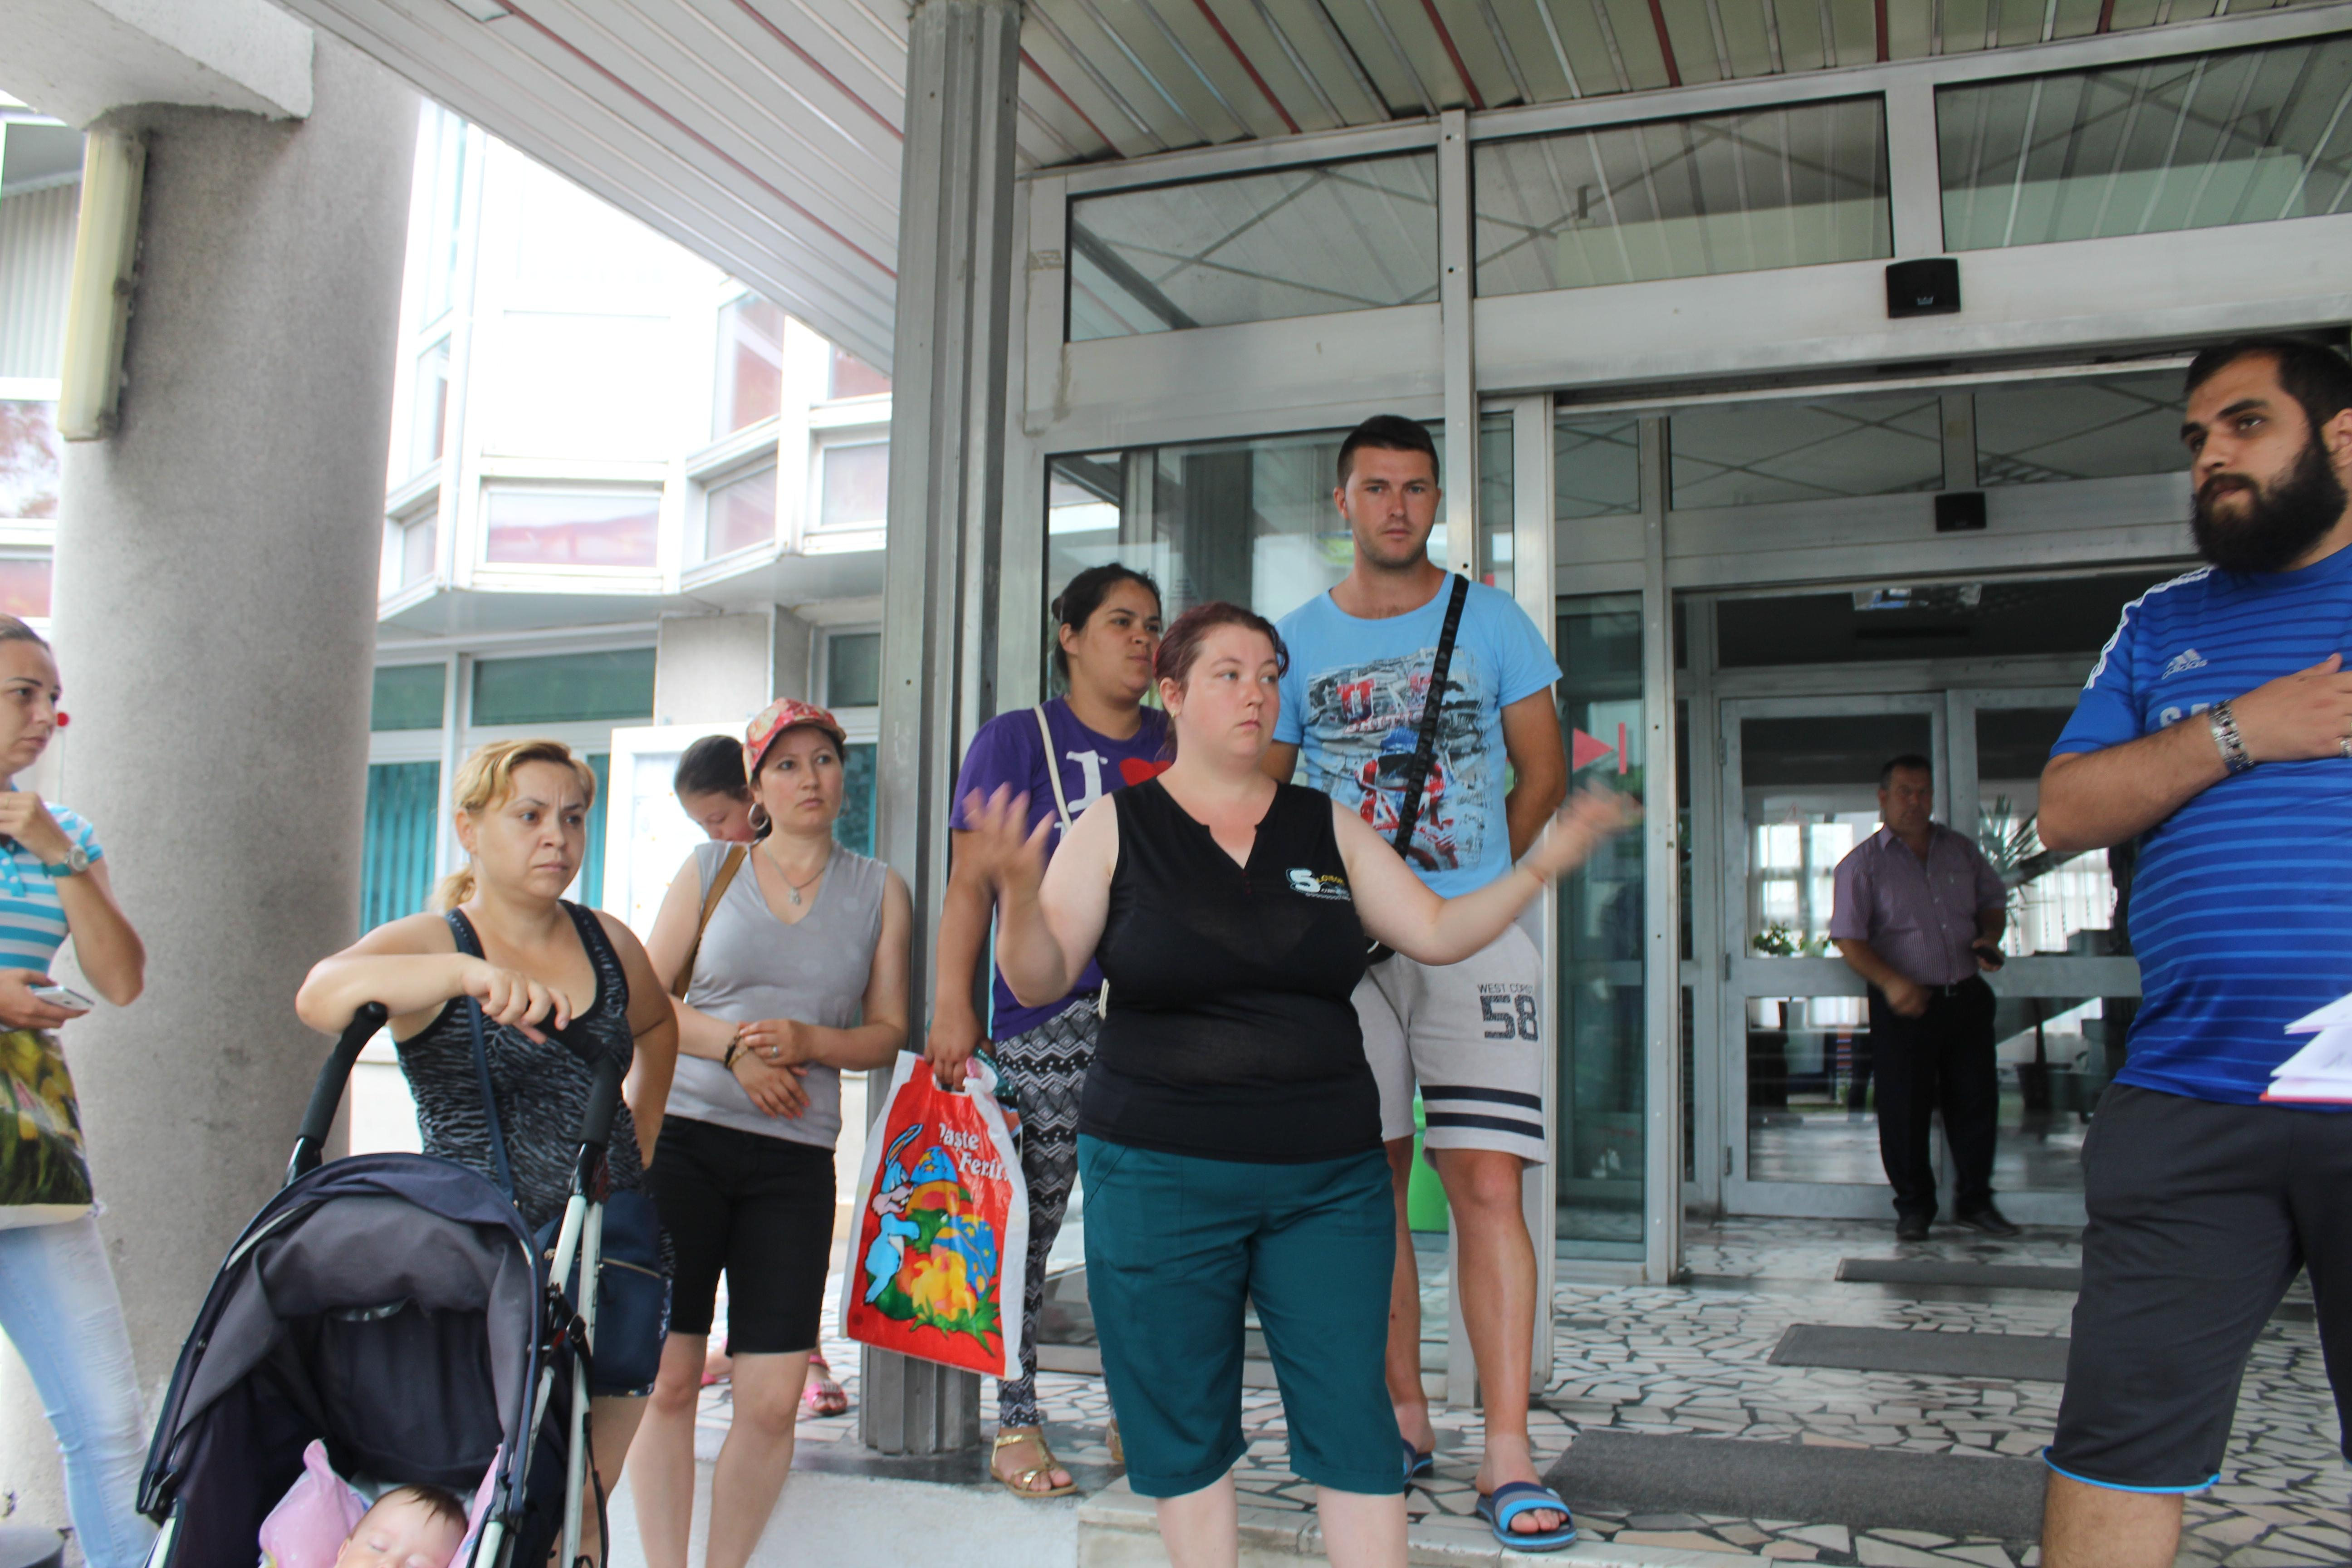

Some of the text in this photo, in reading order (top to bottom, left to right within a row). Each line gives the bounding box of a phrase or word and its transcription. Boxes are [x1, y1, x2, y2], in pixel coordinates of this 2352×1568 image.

[2161, 659, 2208, 680] adidas
[1477, 983, 1505, 994] WEST
[1480, 995, 1539, 1042] 58
